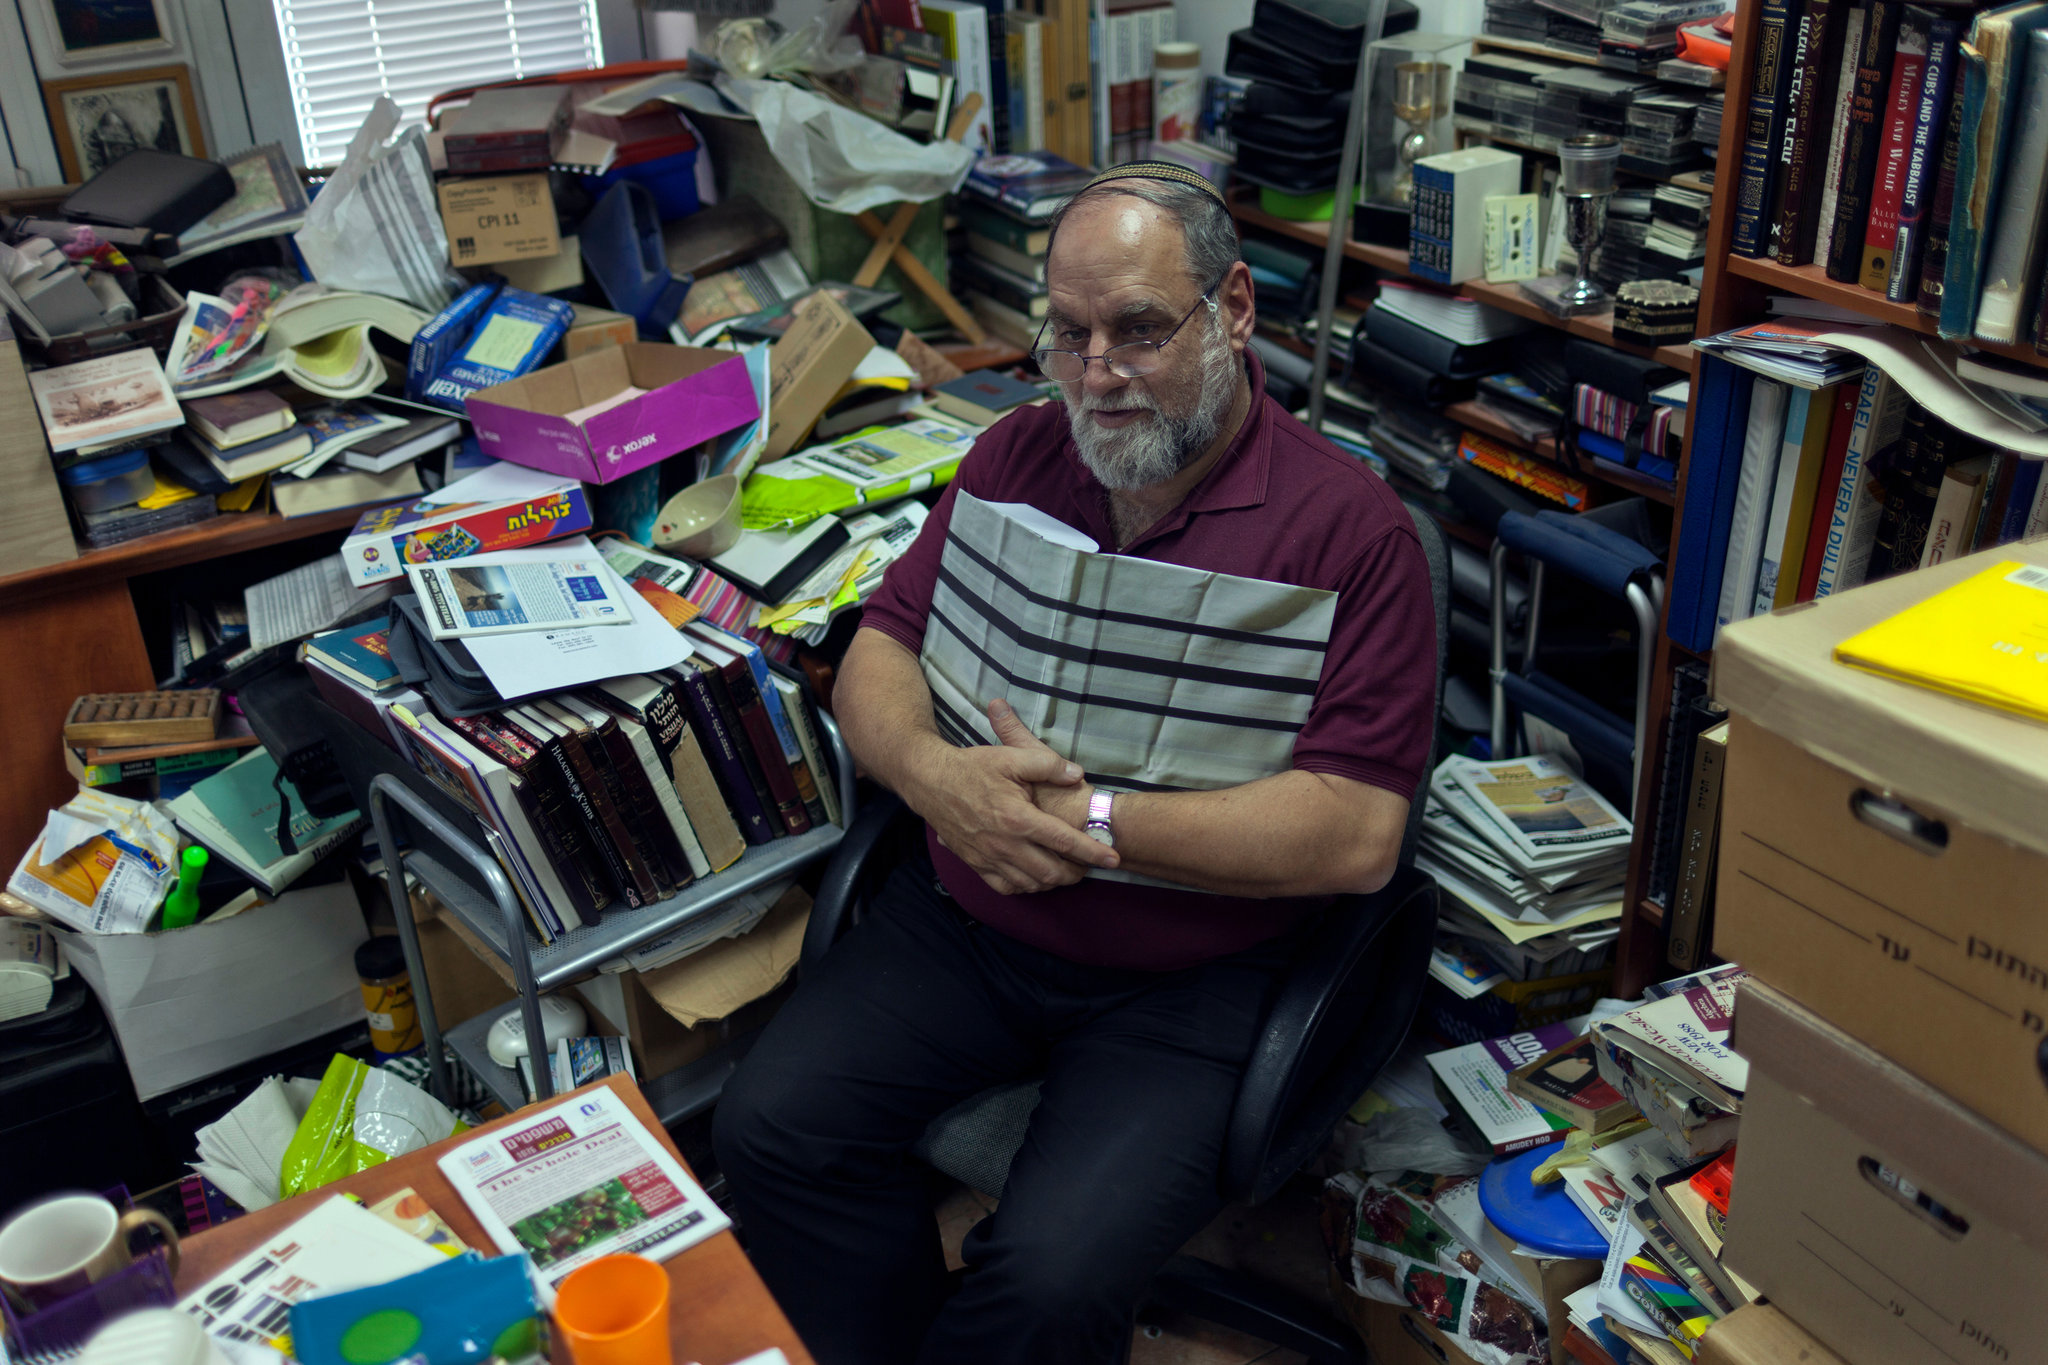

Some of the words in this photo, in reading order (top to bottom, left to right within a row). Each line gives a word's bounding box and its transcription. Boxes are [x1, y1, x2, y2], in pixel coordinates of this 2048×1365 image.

[1795, 16, 1810, 64] תלמוד
[1849, 33, 1860, 74] SHUDOFSKY
[1931, 41, 1944, 63] THE
[1789, 67, 1803, 104] בבלי
[1898, 63, 1917, 112] MICKEY
[1924, 64, 1939, 95] CUBS
[1920, 97, 1932, 122] AND
[1781, 117, 1796, 164] ברכות
[1893, 120, 1904, 141] AND
[1915, 125, 1928, 146] THE
[1884, 148, 1903, 191] WILLIE
[1904, 147, 1924, 206] KABBALIST
[478, 215, 500, 229] CPI
[504, 213, 520, 226] 11
[1771, 223, 1781, 236] א
[1871, 217, 1897, 230] BARR
[427, 378, 478, 401] xell
[1852, 362, 1880, 433] ISRAEL
[623, 433, 656, 455] xerox
[1837, 449, 1861, 513] NEVER
[508, 502, 572, 531] צוללות
[1832, 514, 1846, 529] A
[365, 550, 379, 560] 4+
[1821, 527, 1842, 575] DULL
[650, 692, 675, 724] מילון
[659, 703, 678, 726] חזותי
[659, 714, 682, 738] VISUAL
[551, 744, 575, 787] HALACHOS
[576, 792, 595, 821] K'ZAYIS
[1876, 932, 1910, 962] עד
[1966, 935, 2048, 991] התוכן
[1675, 1036, 1706, 1054] NEW
[1677, 1022, 1705, 1041] 1988
[1495, 1039, 1526, 1066] AMUDEY
[1701, 1042, 1729, 1060] FOR
[504, 1118, 566, 1151] משפטים
[538, 1132, 572, 1150] מברכים
[1505, 1138, 1534, 1152] AMUDEY
[1535, 1135, 1550, 1145] HOD
[488, 1172, 523, 1193] The
[526, 1147, 581, 1176] Whole
[584, 1130, 624, 1151] Deal
[1960, 1319, 2009, 1362] התוכן
